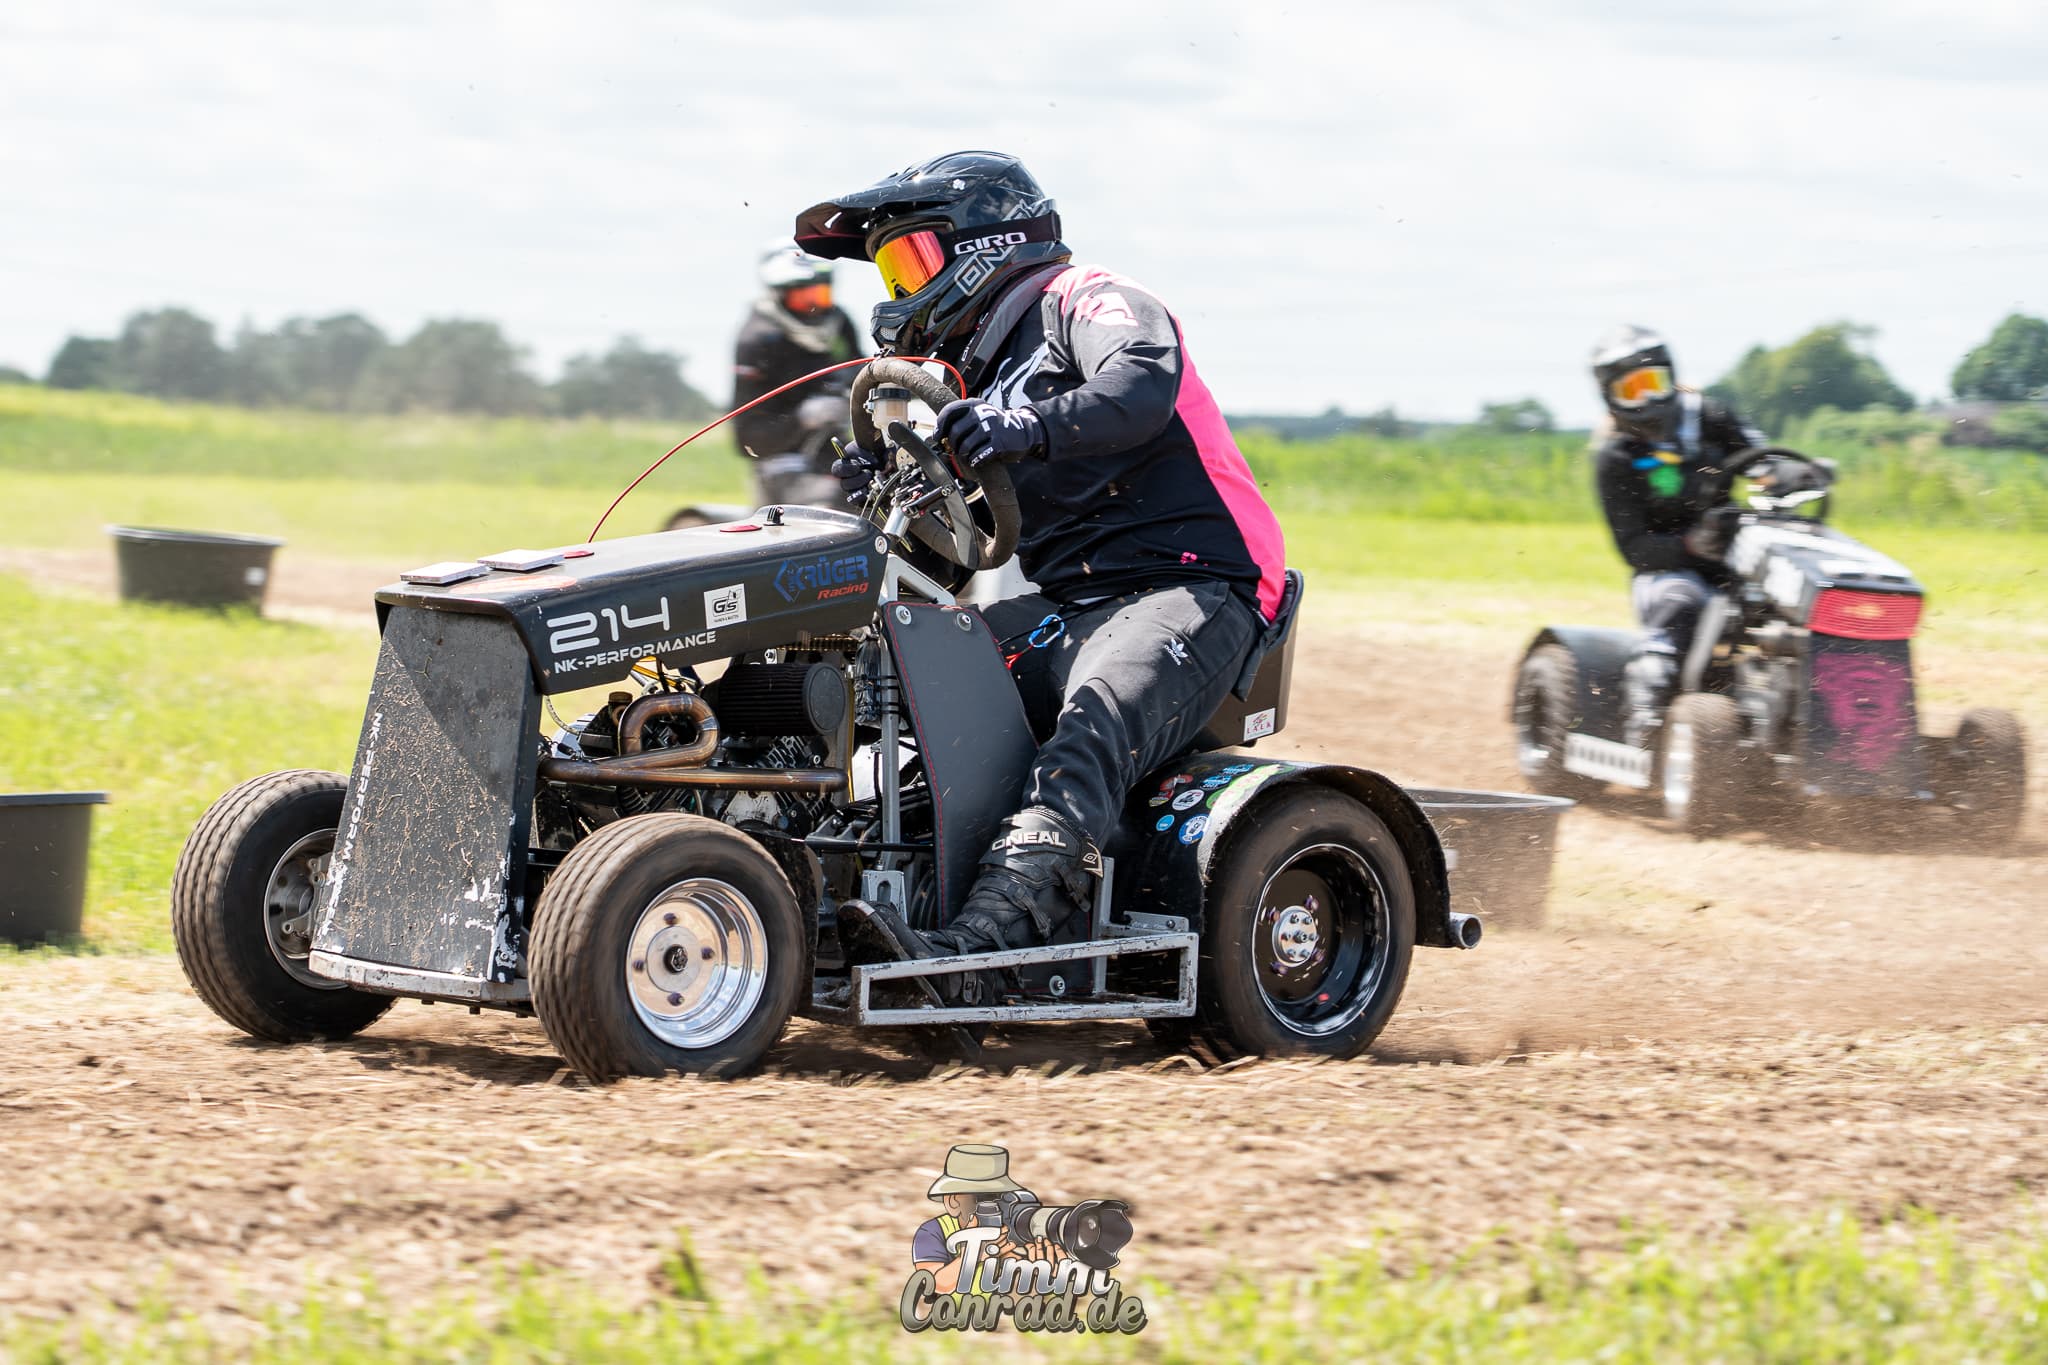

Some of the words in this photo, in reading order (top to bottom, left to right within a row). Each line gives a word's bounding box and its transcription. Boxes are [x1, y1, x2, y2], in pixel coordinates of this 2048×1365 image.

[954, 231, 1027, 255] GIRO
[817, 582, 869, 600] Racing
[546, 596, 671, 654] 214
[554, 630, 717, 675] NK-PERFORMANCE
[991, 831, 1067, 852] ONEAL
